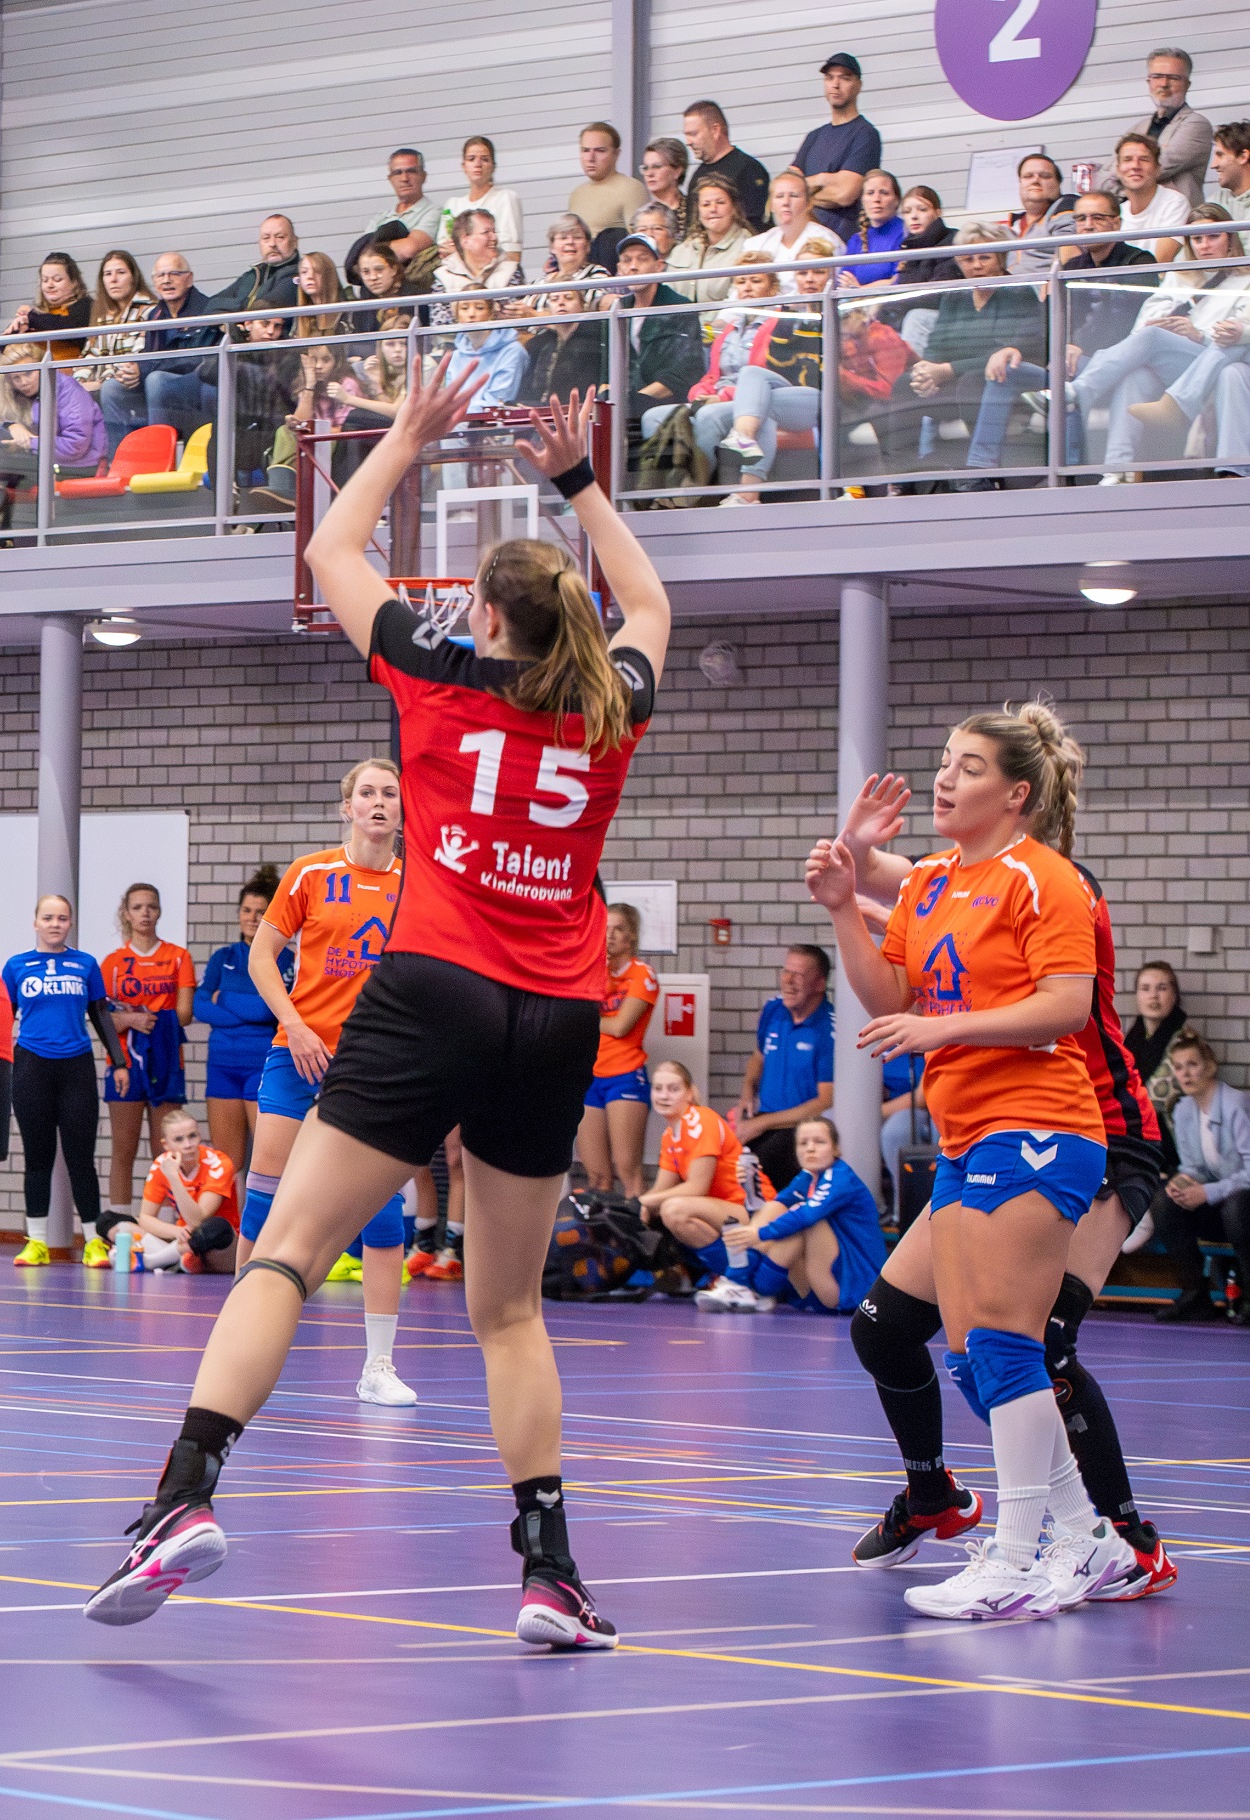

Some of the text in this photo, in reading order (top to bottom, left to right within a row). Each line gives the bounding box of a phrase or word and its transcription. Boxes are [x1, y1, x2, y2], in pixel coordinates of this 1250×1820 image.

[989, 0, 1042, 63] 2
[458, 728, 591, 829] 15
[491, 841, 572, 881] Talent
[324, 872, 351, 903] 11
[915, 875, 949, 917] 3
[45, 958, 57, 976] 1
[122, 956, 136, 975] 7
[327, 946, 342, 957] DE
[43, 981, 84, 996] KLINK
